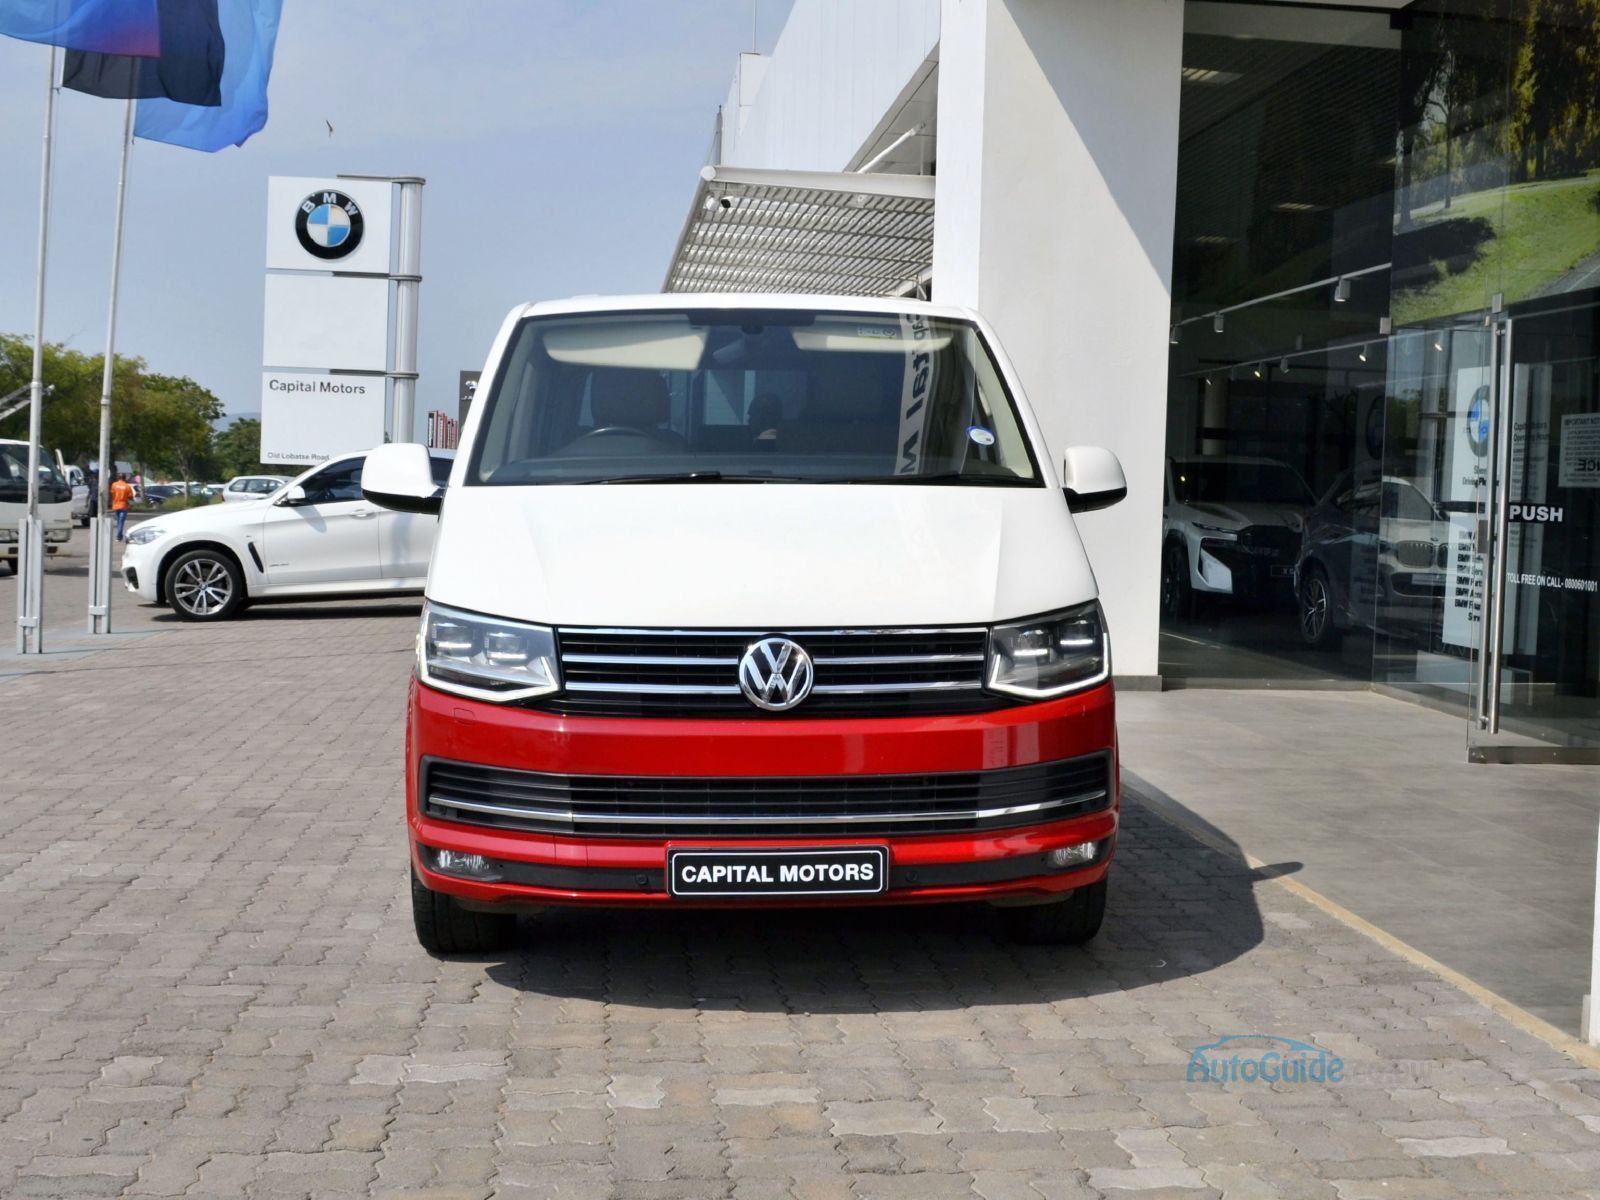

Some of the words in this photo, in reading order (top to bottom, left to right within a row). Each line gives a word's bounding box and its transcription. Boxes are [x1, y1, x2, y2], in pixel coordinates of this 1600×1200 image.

[269, 379, 316, 393] Capital
[319, 382, 366, 394] Motors
[1509, 505, 1564, 522] PUSH
[1506, 572, 1520, 584] TOLL
[1521, 573, 1536, 585] FREE
[1537, 575, 1546, 586] ON
[1564, 578, 1598, 592] 0800601001
[681, 865, 774, 883] CAPITAL
[780, 863, 874, 882] MOTORS
